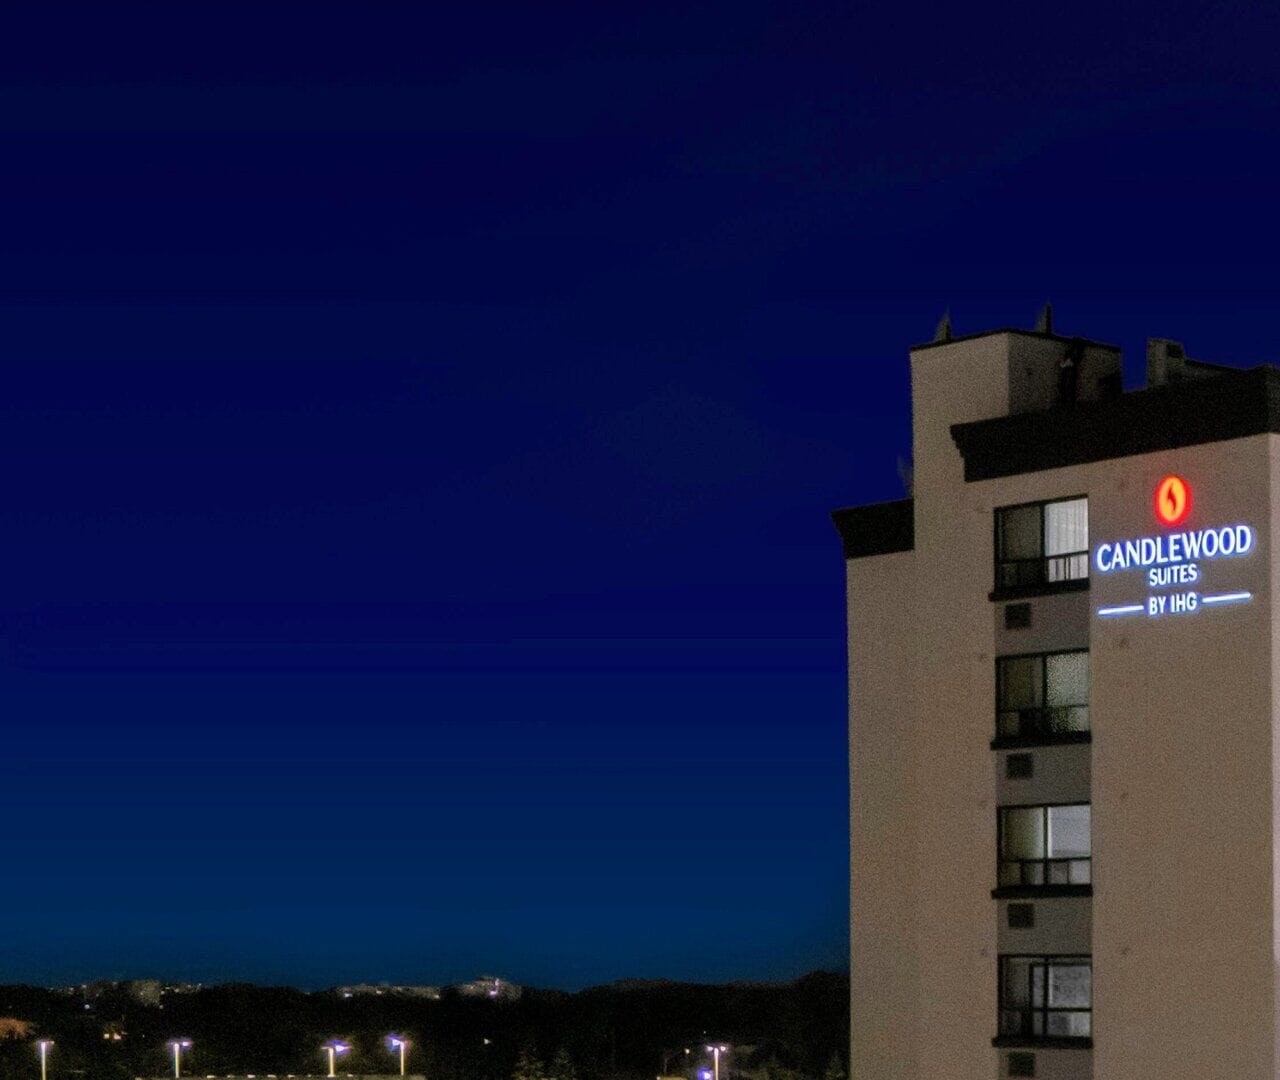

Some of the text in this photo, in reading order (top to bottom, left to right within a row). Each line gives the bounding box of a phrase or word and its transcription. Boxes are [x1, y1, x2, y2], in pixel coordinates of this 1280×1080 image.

[1096, 525, 1252, 572] CANDLEWOOD
[1149, 563, 1198, 586] SUITES
[1148, 592, 1198, 616] BY IHG
